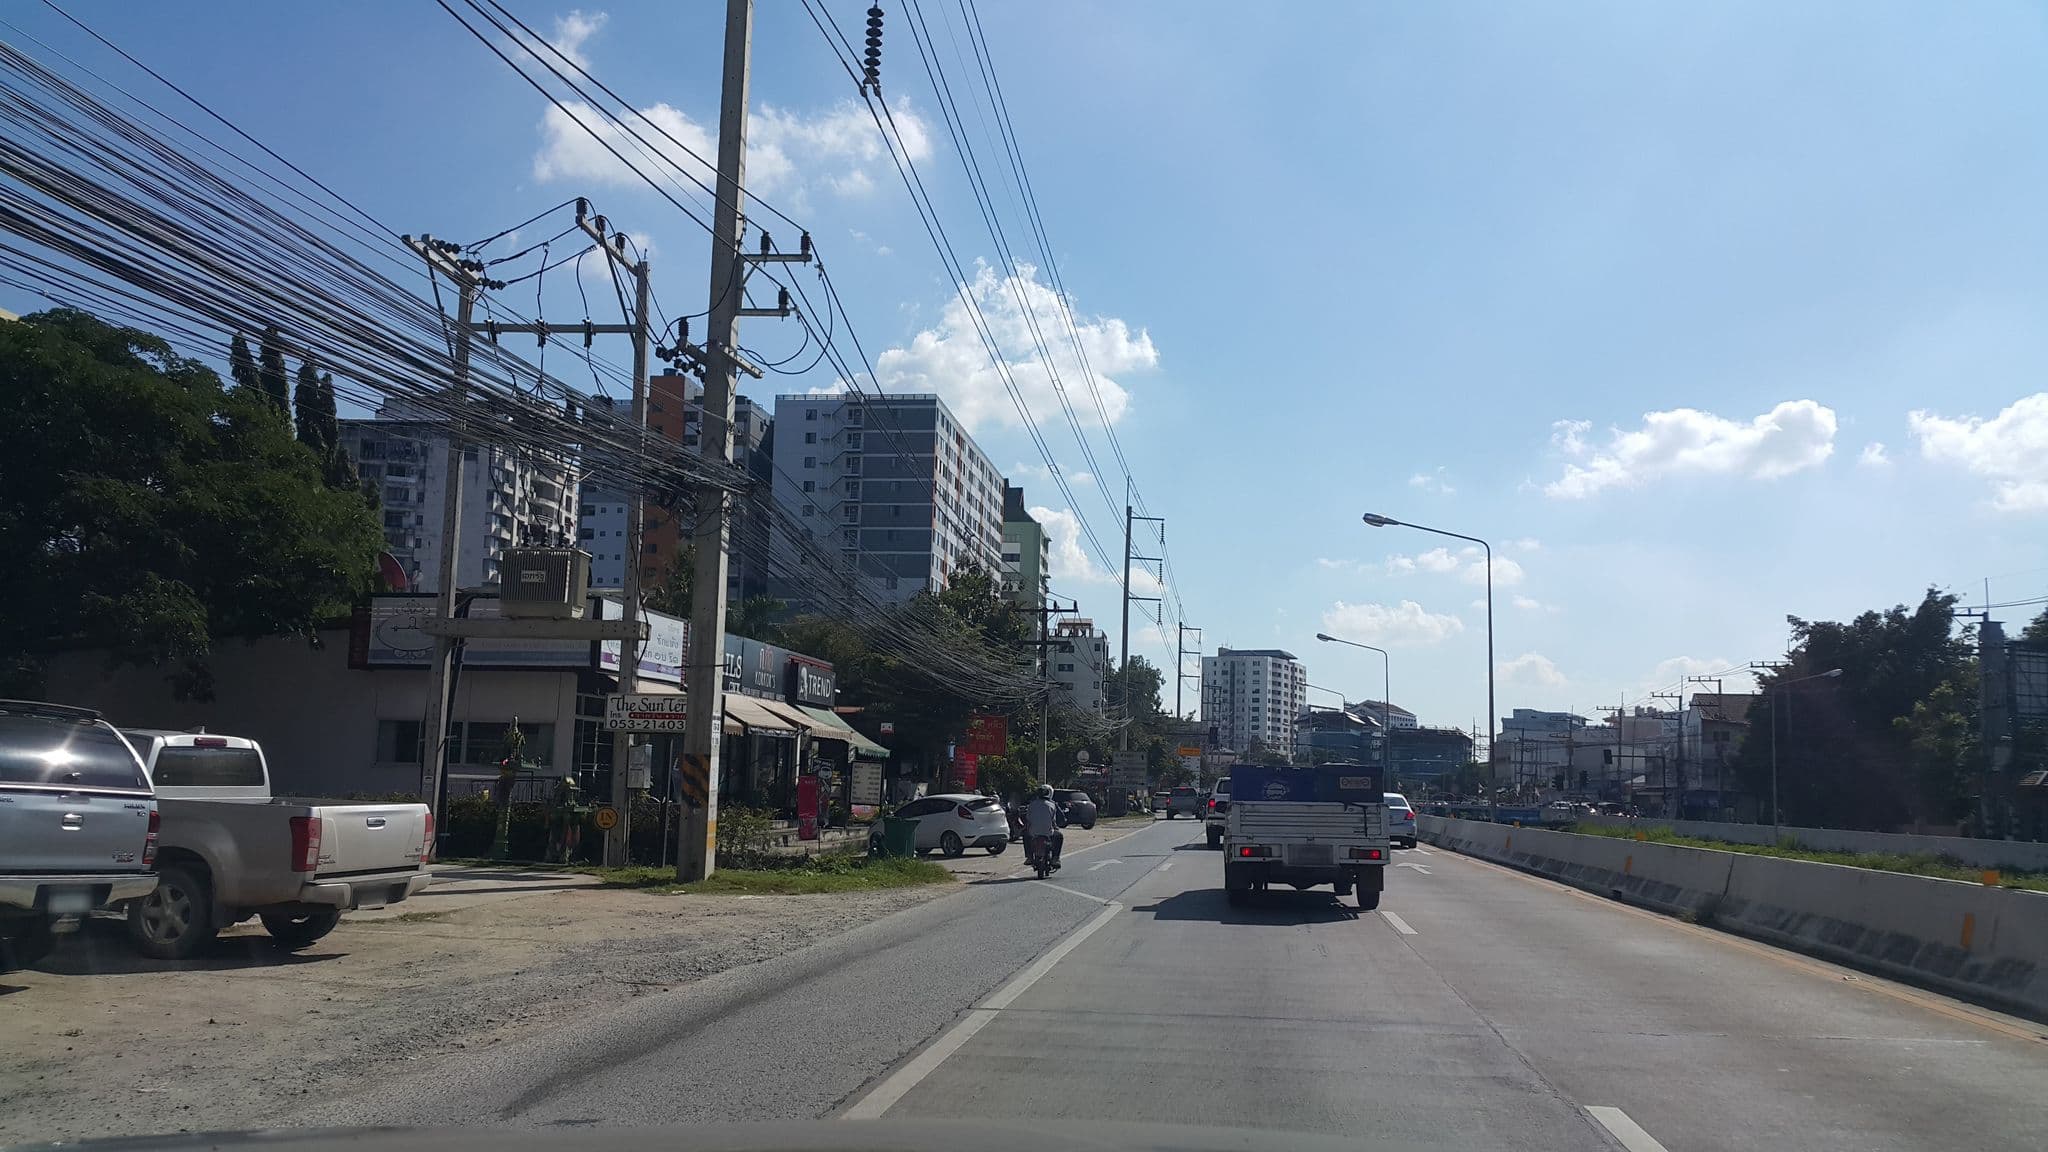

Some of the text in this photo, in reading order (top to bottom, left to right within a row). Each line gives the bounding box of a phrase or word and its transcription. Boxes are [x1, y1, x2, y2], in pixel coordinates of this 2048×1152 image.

[808, 674, 831, 697] TREND
[610, 695, 637, 711] The
[609, 719, 685, 730] 053-21403
